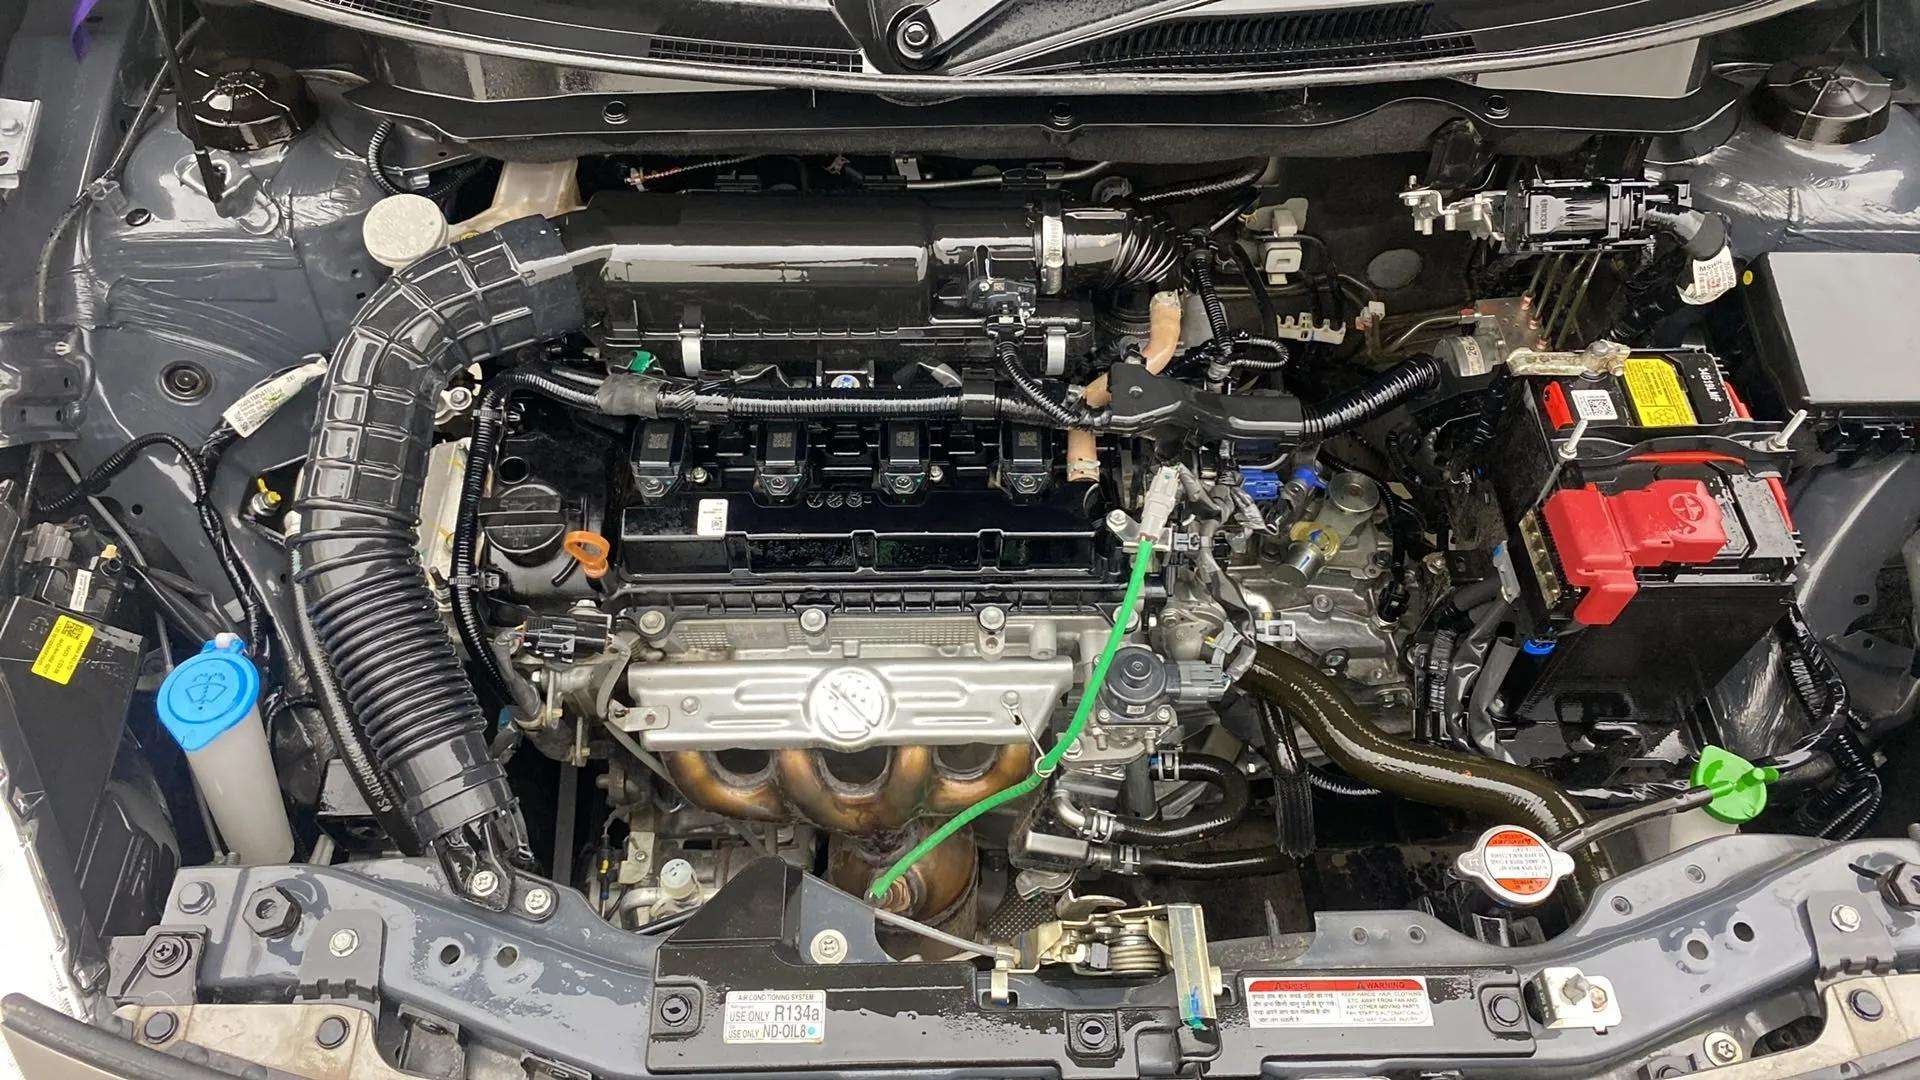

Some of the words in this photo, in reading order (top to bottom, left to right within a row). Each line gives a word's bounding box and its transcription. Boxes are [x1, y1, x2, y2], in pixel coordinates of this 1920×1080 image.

[730, 1011, 746, 1021] USE
[748, 1011, 770, 1021] ONLY
[774, 1005, 819, 1021] R134a
[728, 1030, 741, 1038] USE
[743, 1029, 759, 1038] ONLY
